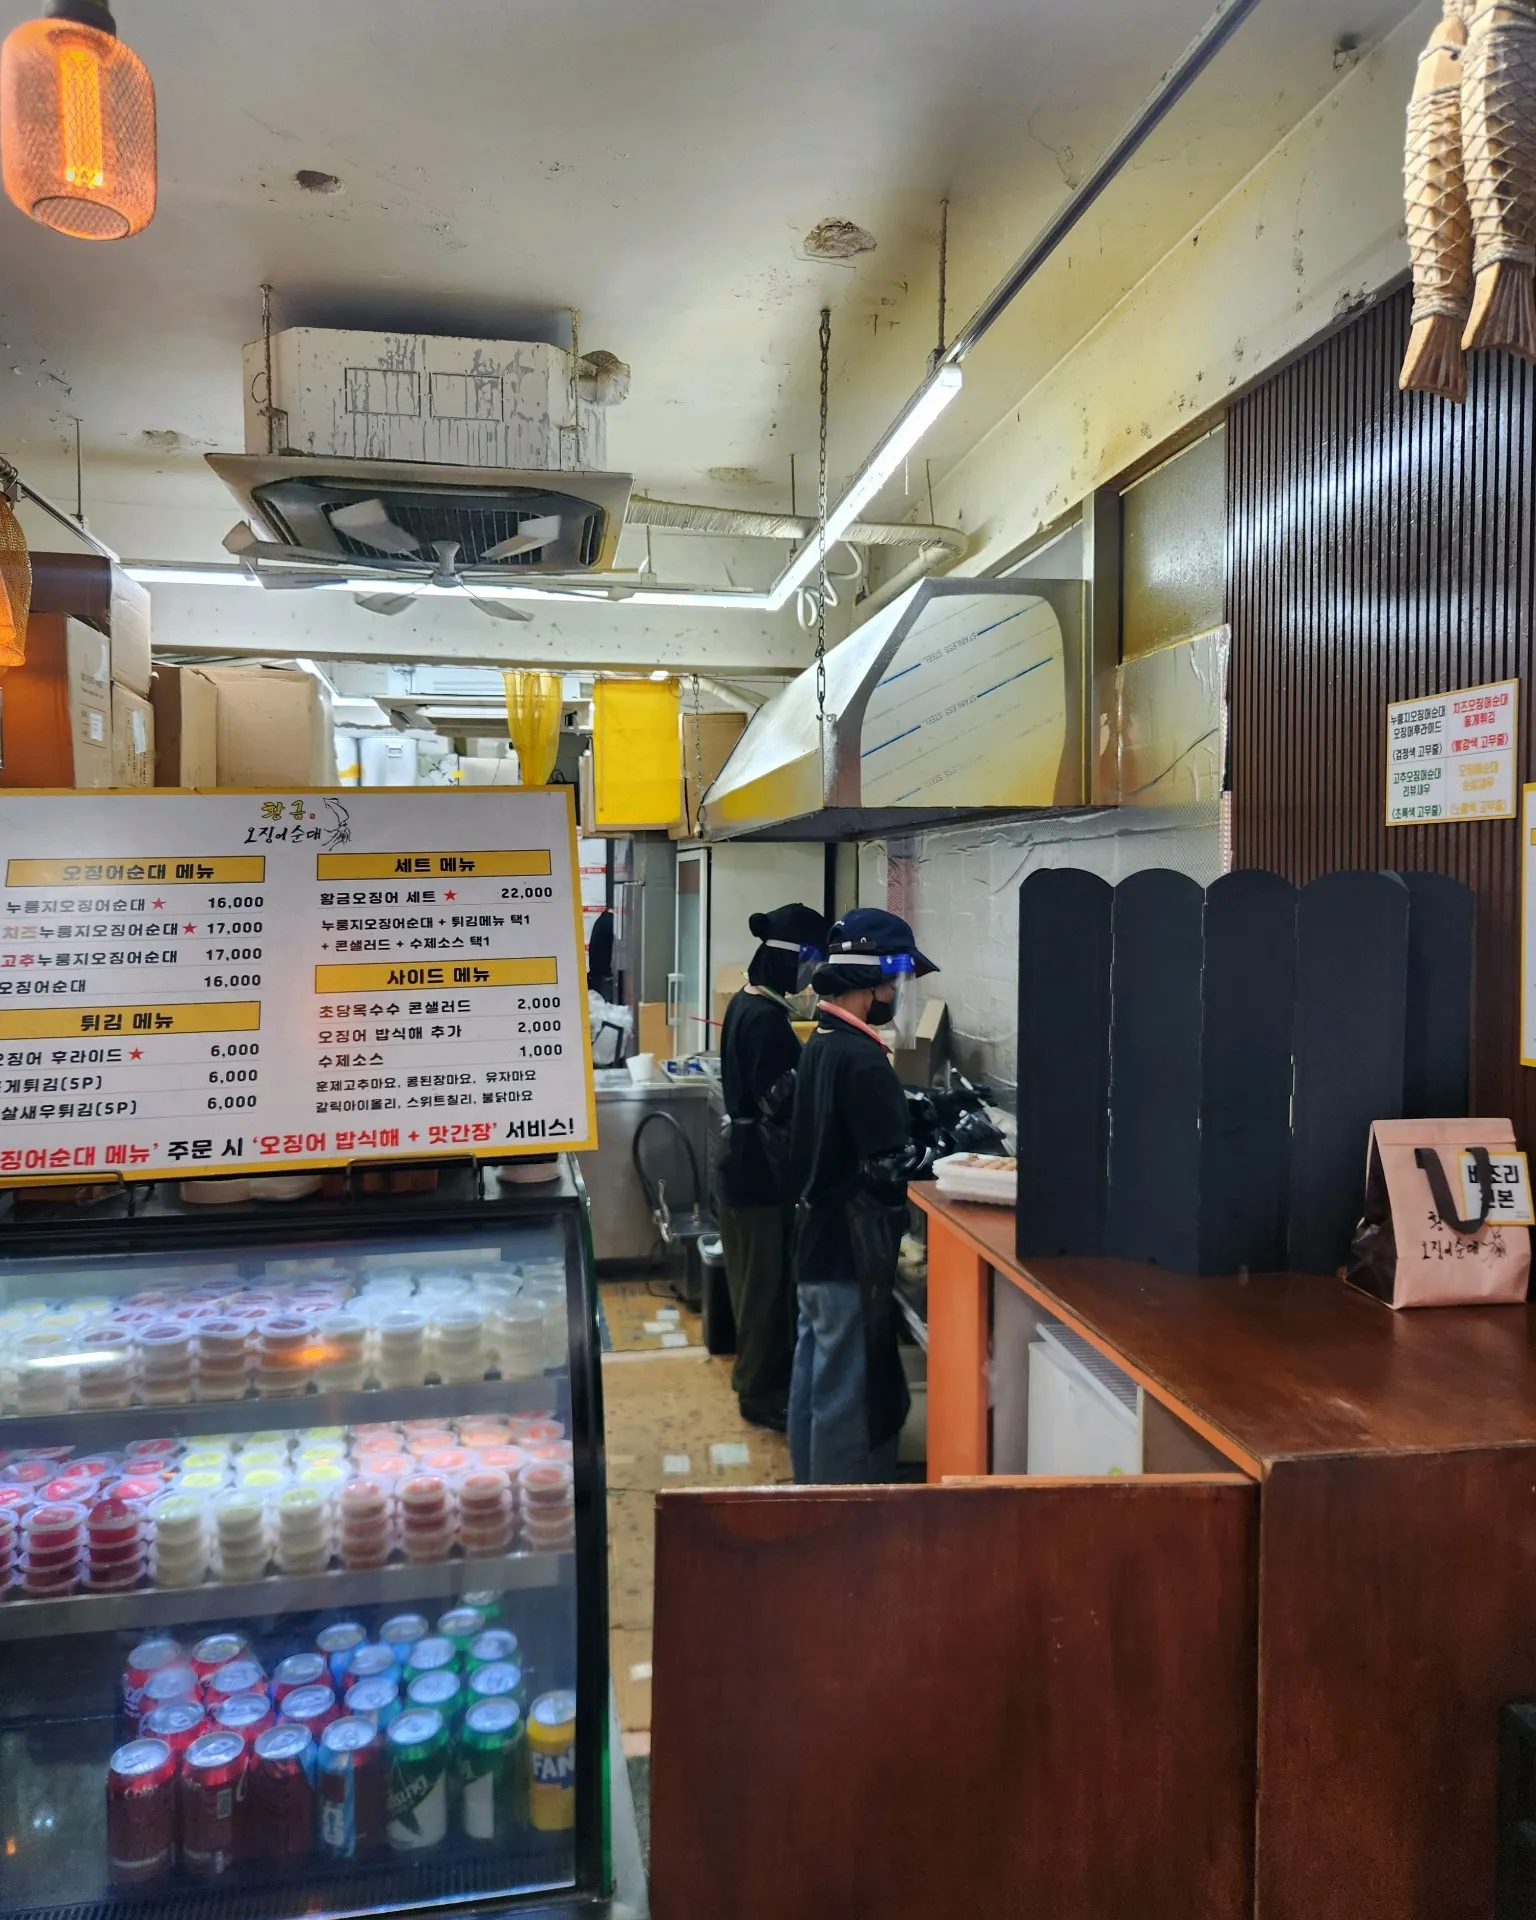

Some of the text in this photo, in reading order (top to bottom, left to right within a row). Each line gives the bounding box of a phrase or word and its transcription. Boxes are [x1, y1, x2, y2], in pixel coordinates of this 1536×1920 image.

[261, 799, 306, 821] 황금
[243, 825, 321, 844] 오징어순대
[62, 862, 214, 881] 오징어순대 메뉴
[395, 857, 476, 873] 세트 메뉴
[6, 896, 264, 914] 누룽지오징어순대 16,000
[320, 886, 553, 905] 황금오징어 세트 22,000
[2, 921, 263, 939] 치즈누룽지오징어순대 17,000
[322, 917, 433, 931] 누룽지오징어순대
[451, 914, 505, 928] 튀김메뉴
[511, 913, 530, 926] 택1
[335, 938, 391, 952] 콘샐러드
[410, 936, 464, 950] 수제소스
[470, 935, 490, 947] 택1
[1, 947, 262, 967] 고추누룽지오징어순대 17,000
[0, 974, 261, 995] 오징어순대 16,000
[387, 966, 490, 986] 사이드 메뉴
[319, 996, 561, 1018] 초당옥수수 콘샐러드 2,000
[80, 1011, 174, 1032] 튀김 메뉴
[318, 1020, 561, 1044] 오징어 밥식해 추가 2,000
[51, 1048, 123, 1065] 후라이드
[210, 1042, 259, 1058] 6,000
[318, 1044, 563, 1068] 수제소스 1,000
[0, 1068, 258, 1093] 게튀김(5P) 6,000
[486, 1069, 537, 1082] 유자마요
[207, 1095, 257, 1111] 6,000
[482, 1090, 534, 1104] 불닭마요
[168, 1139, 213, 1161] 주문
[222, 1136, 243, 1158] 시
[335, 1128, 399, 1150] 밥식해
[506, 1117, 574, 1140] 서비스!
